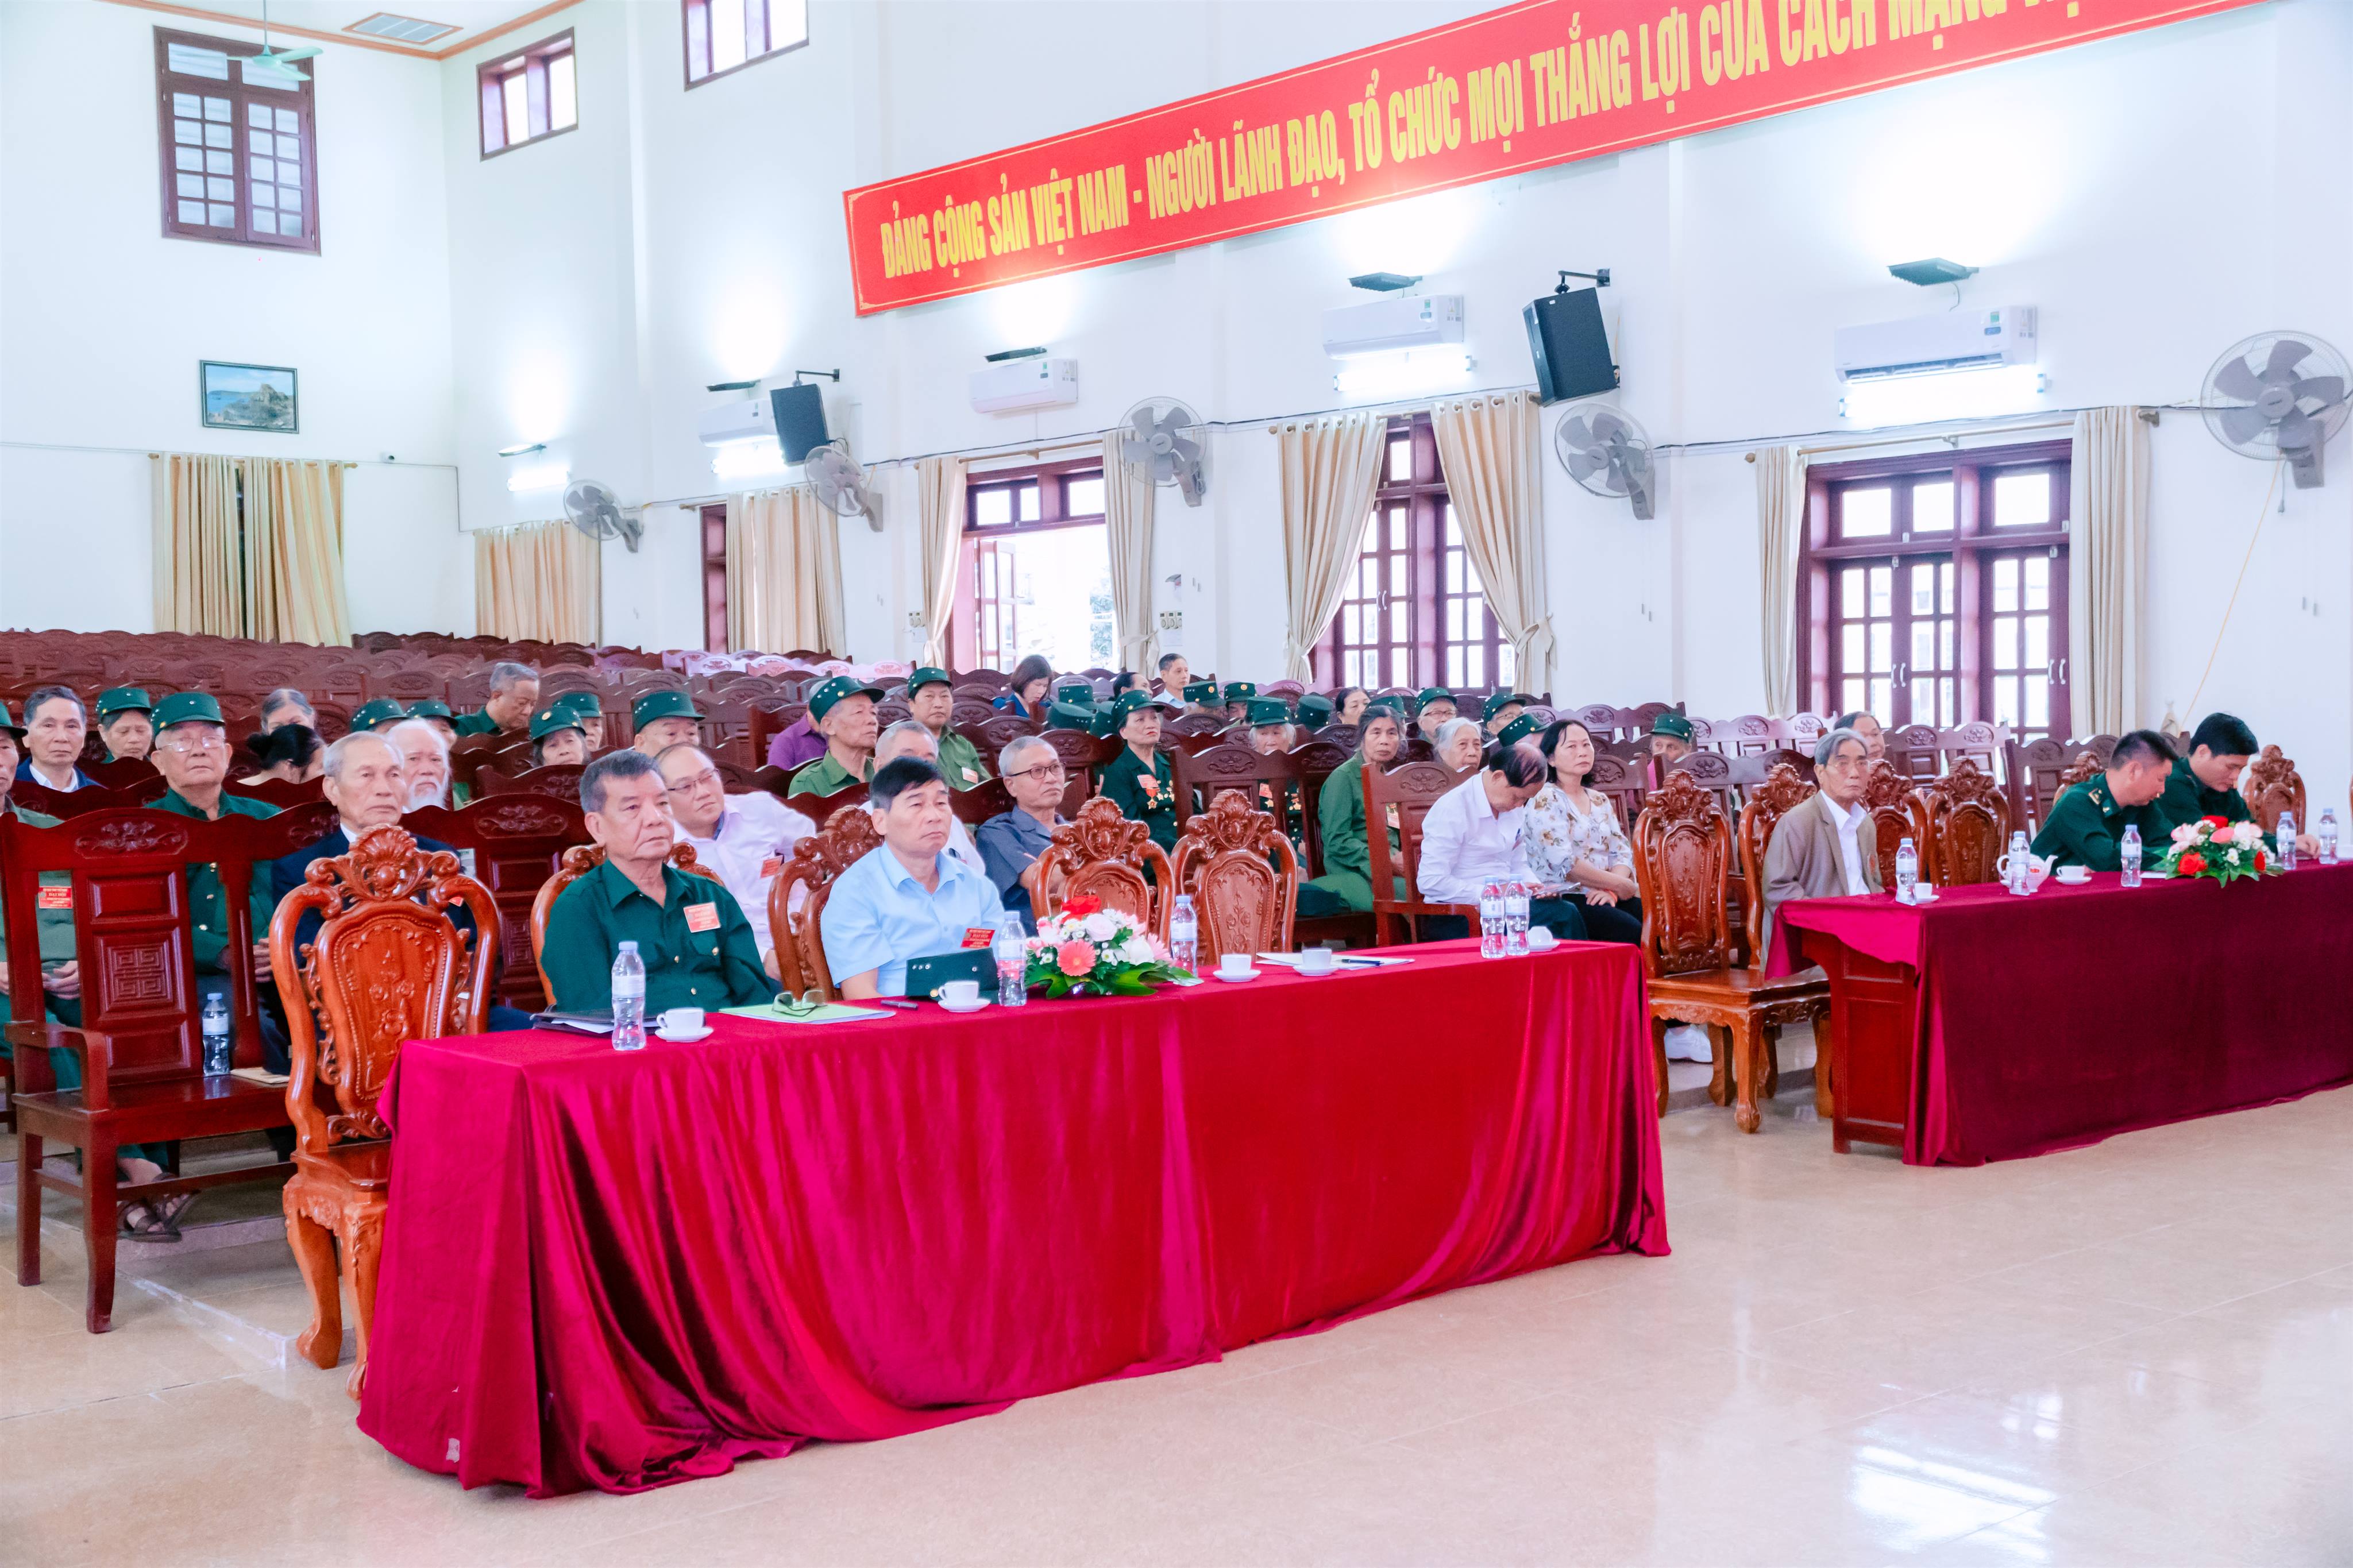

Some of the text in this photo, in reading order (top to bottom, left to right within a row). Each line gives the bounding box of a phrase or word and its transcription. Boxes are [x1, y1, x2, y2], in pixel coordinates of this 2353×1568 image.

[880, 201, 932, 279] ĐẢNG
[932, 195, 987, 278] CỘNG
[986, 173, 1031, 257] SẢN
[1030, 168, 1074, 256] VIỆT
[1077, 164, 1129, 236] NAM
[1145, 128, 1217, 219] NGƯỜI
[1219, 120, 1284, 203] LÃNH
[1286, 109, 1347, 198] ĐẠO,
[1348, 68, 1383, 172] TỔ
[1388, 66, 1461, 164] CHỨC
[1467, 59, 1524, 153] MỌI
[1529, 13, 1631, 127] THẮNG
[1640, 6, 1691, 114] LỢI
